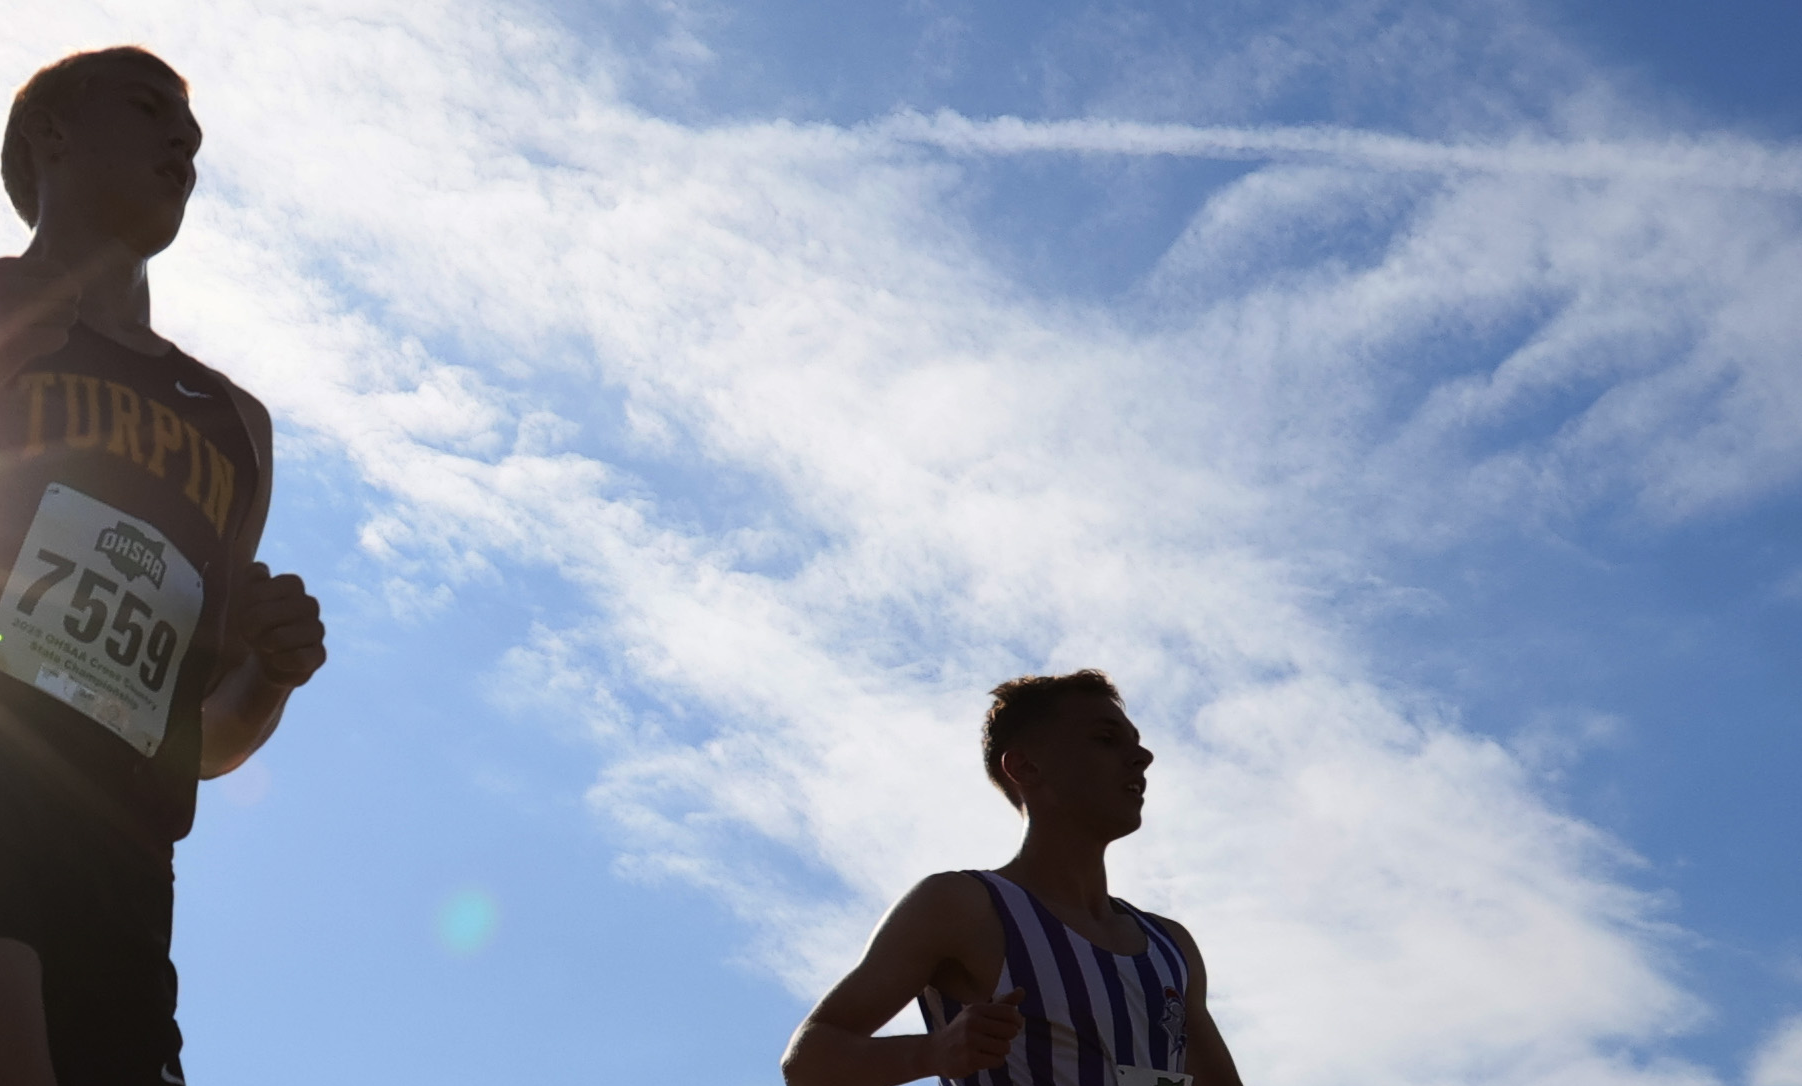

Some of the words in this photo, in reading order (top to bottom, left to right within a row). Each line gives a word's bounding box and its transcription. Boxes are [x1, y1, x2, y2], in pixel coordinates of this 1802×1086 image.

[18, 372, 235, 540] TURPIN
[16, 548, 178, 693] 7559
[101, 531, 165, 583] OHSAA
